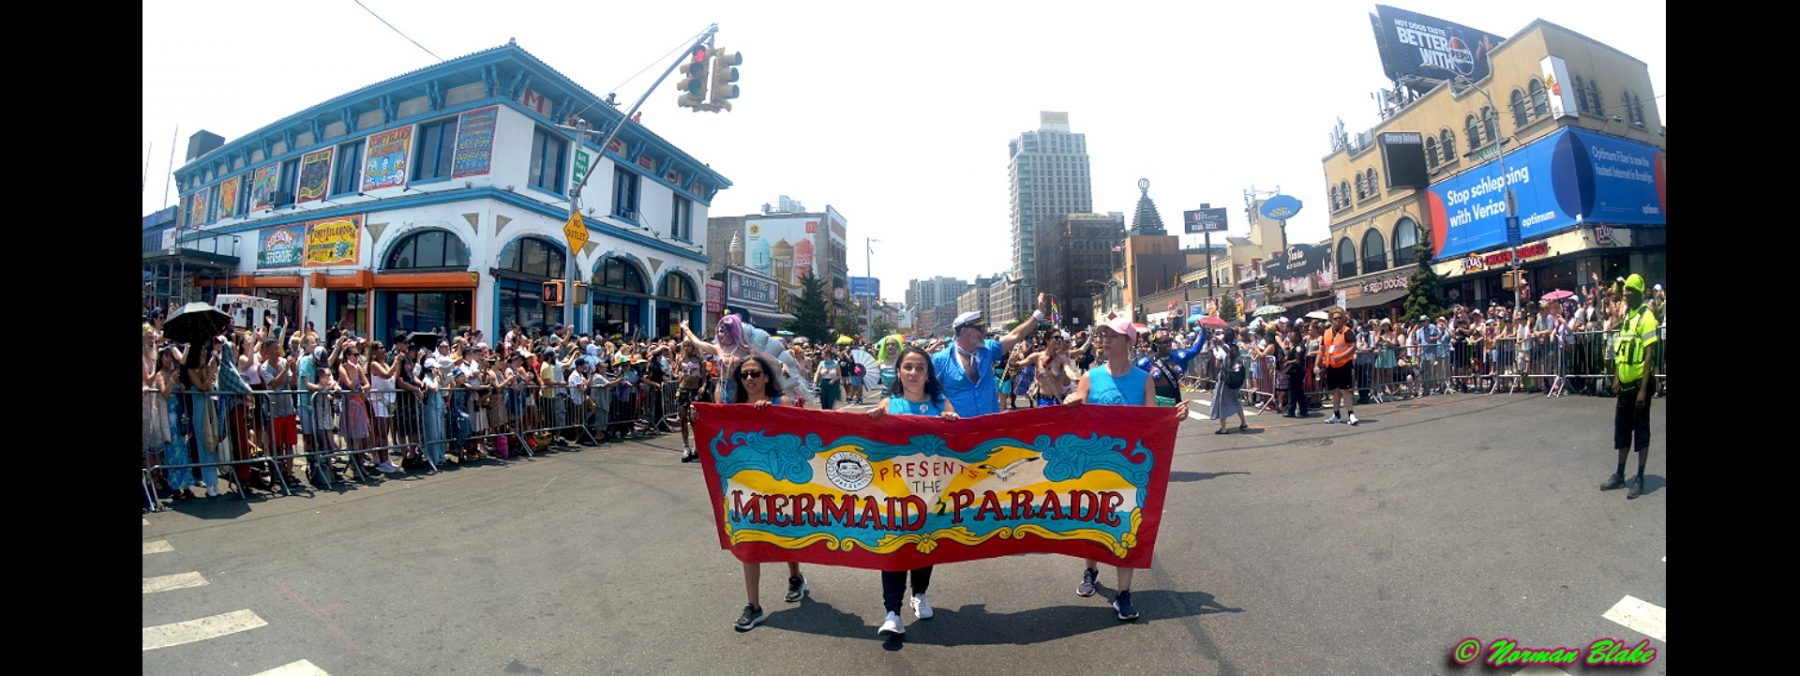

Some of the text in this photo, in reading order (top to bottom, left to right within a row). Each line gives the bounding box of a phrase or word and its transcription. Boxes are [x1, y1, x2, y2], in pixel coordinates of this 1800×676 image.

[1426, 25, 1446, 36] TASTE
[1396, 26, 1450, 53] BETTER
[1419, 47, 1456, 69] WITH
[1402, 133, 1420, 142] Island
[1447, 189, 1469, 206] Stop
[573, 219, 582, 228] NO
[1449, 208, 1472, 228] with
[566, 229, 586, 241] OUTLET
[1463, 256, 1483, 271] TEXAS
[743, 289, 766, 300] GALLERY
[880, 460, 979, 481] PRESENTS
[912, 480, 942, 494] THE
[731, 488, 1125, 531] MERMAID PARADE
